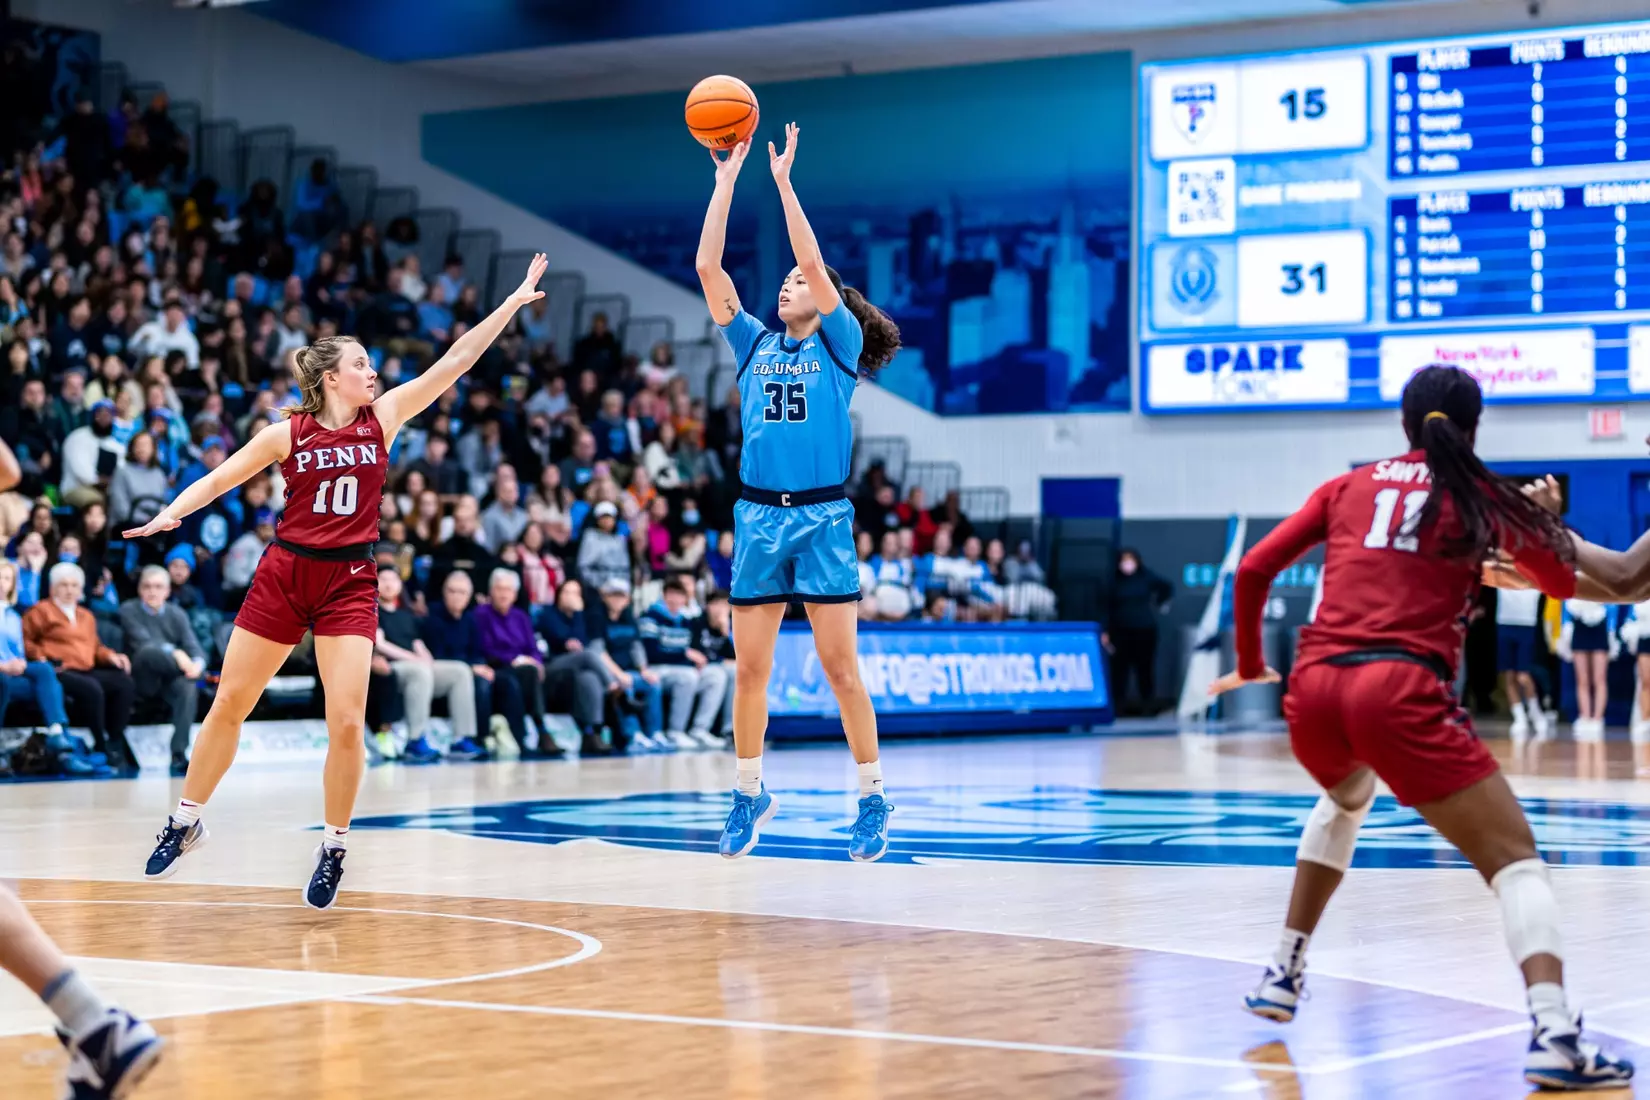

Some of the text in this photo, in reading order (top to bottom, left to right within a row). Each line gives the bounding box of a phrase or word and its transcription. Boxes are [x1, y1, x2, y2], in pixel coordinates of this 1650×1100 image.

[1280, 88, 1327, 121] 15
[1280, 262, 1327, 294] 31
[753, 360, 821, 376] COLUMBIA
[763, 380, 808, 423] 35
[294, 444, 378, 473] PENN
[312, 475, 359, 516] 10
[781, 493, 791, 507] C
